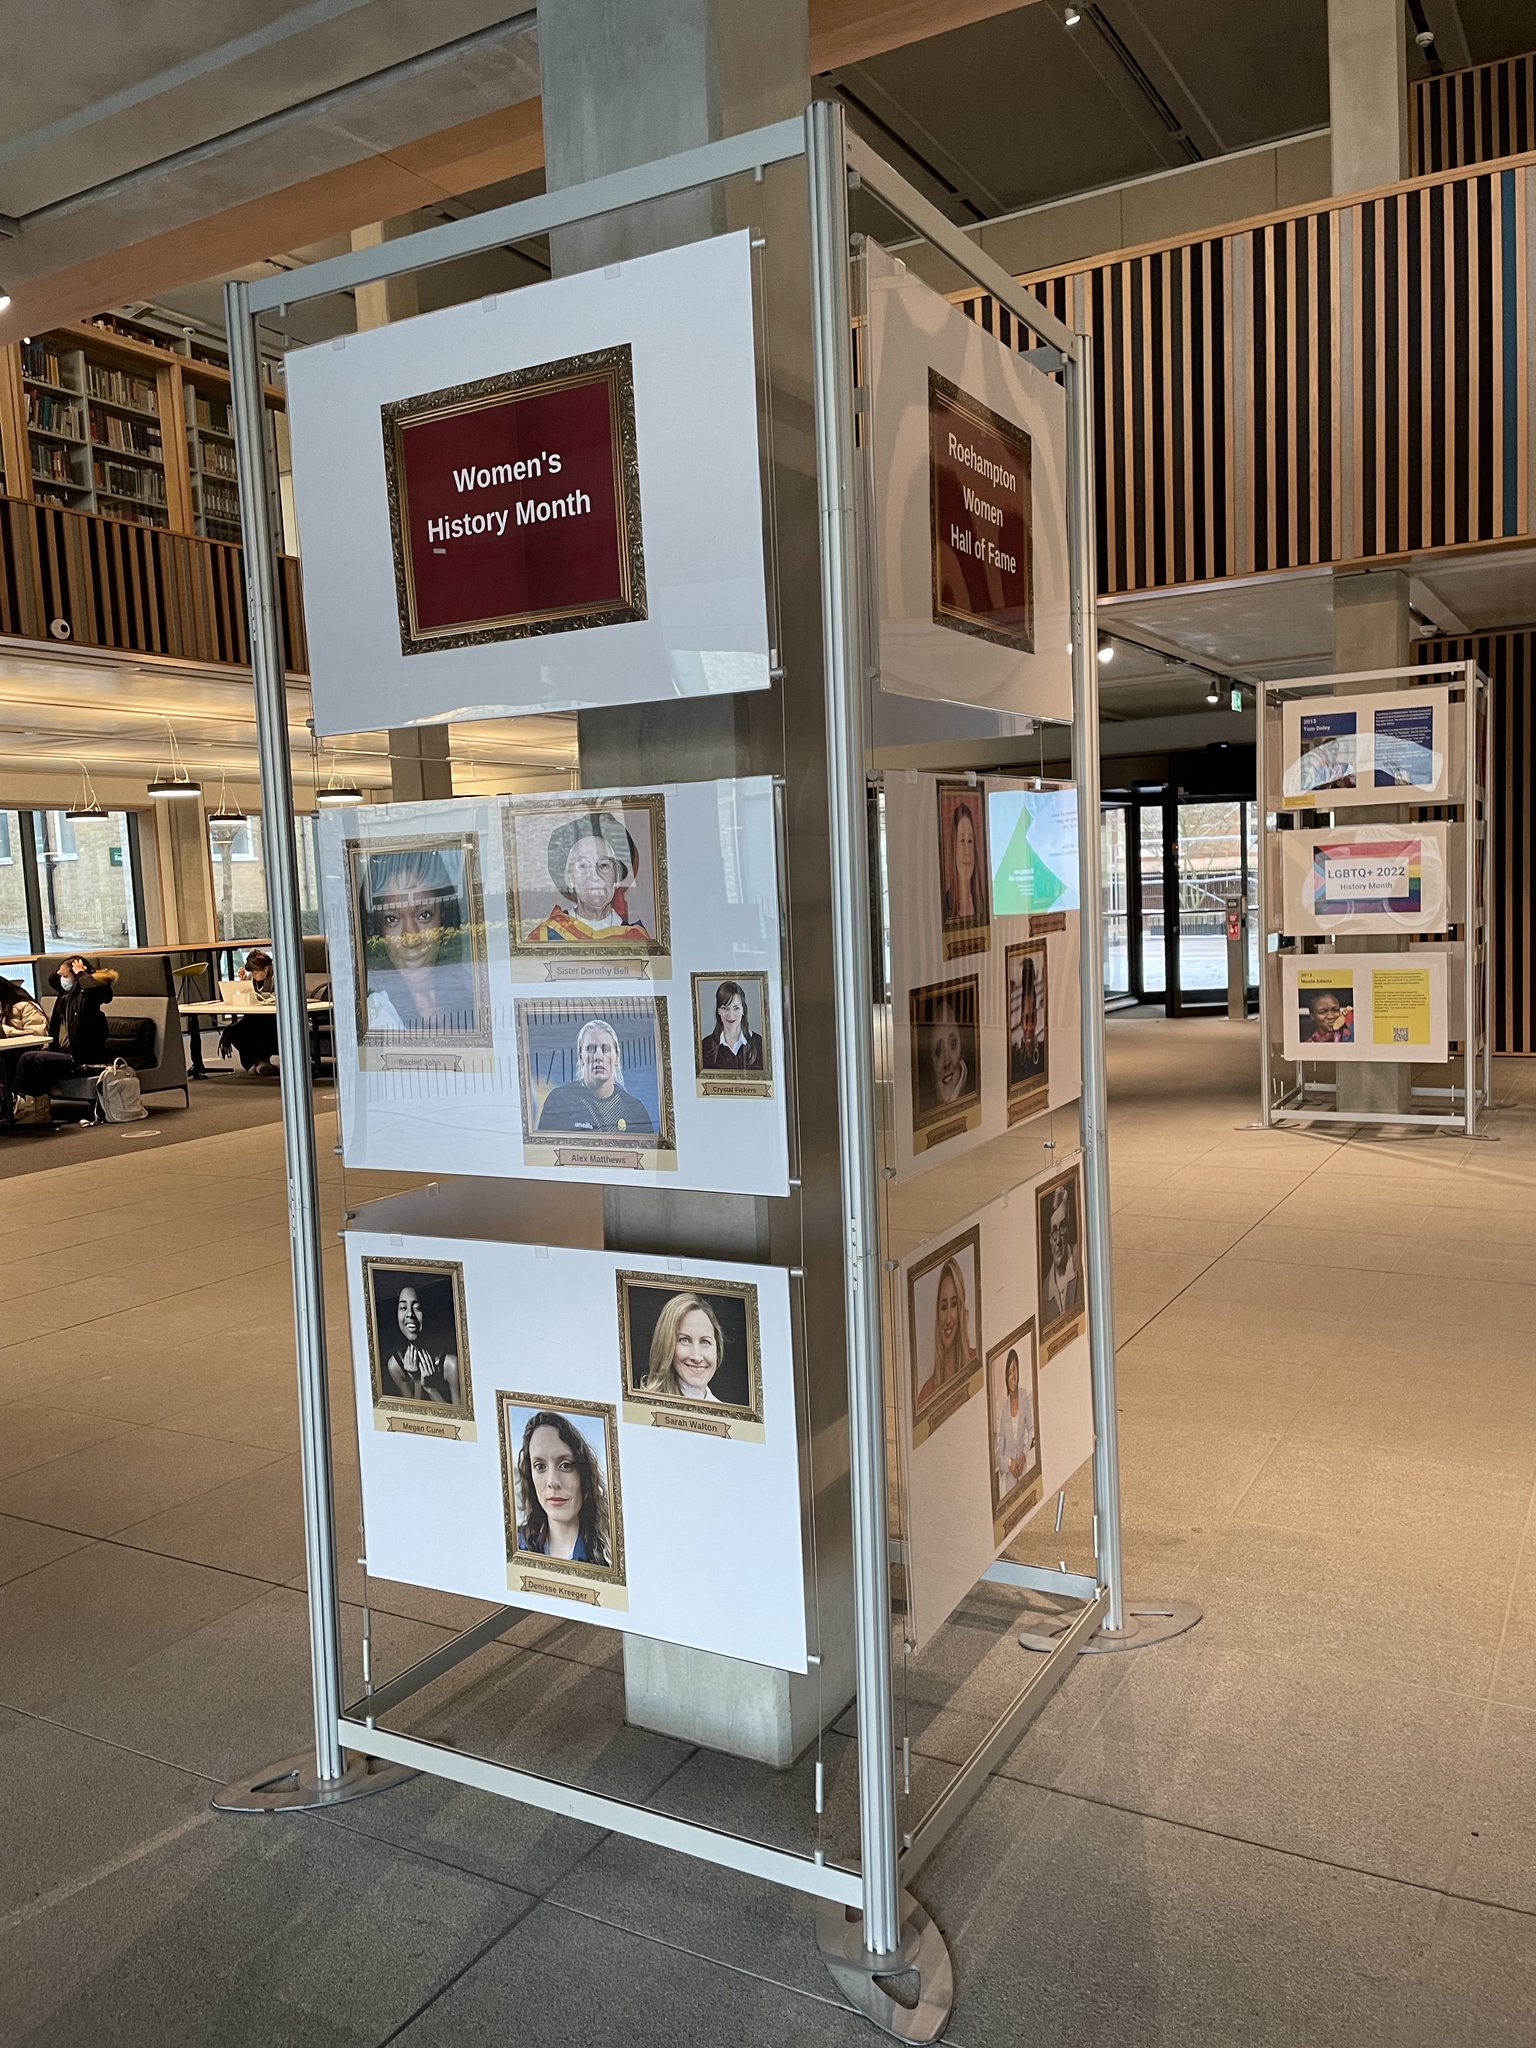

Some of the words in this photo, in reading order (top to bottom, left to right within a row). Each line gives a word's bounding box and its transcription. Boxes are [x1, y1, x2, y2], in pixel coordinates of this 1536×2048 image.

[948, 432, 1016, 492] Roehampton
[452, 451, 562, 493] Women's
[963, 485, 1004, 527] Women
[427, 509, 509, 543] History
[515, 489, 591, 526] Month
[951, 523, 972, 555] Hall
[974, 538, 986, 561] of
[988, 542, 1017, 574] Fame
[1328, 868, 1374, 879] LGBTQ+
[1376, 867, 1405, 877] 2022
[1340, 883, 1367, 891] History
[1368, 882, 1393, 890] Month
[556, 966, 579, 975] Sister
[580, 966, 612, 976] Dorothy
[613, 966, 629, 975] Bell
[398, 1058, 422, 1066] Rachel
[424, 1059, 442, 1067] John
[571, 1154, 587, 1162] Alex
[589, 1155, 626, 1164] Matthews
[402, 1422, 425, 1432] Megan
[425, 1425, 445, 1435] Curet
[664, 1416, 688, 1428] Sarah
[689, 1420, 718, 1432] Walton
[528, 1581, 557, 1593] Denisse
[558, 1587, 588, 1600] Kreeger
